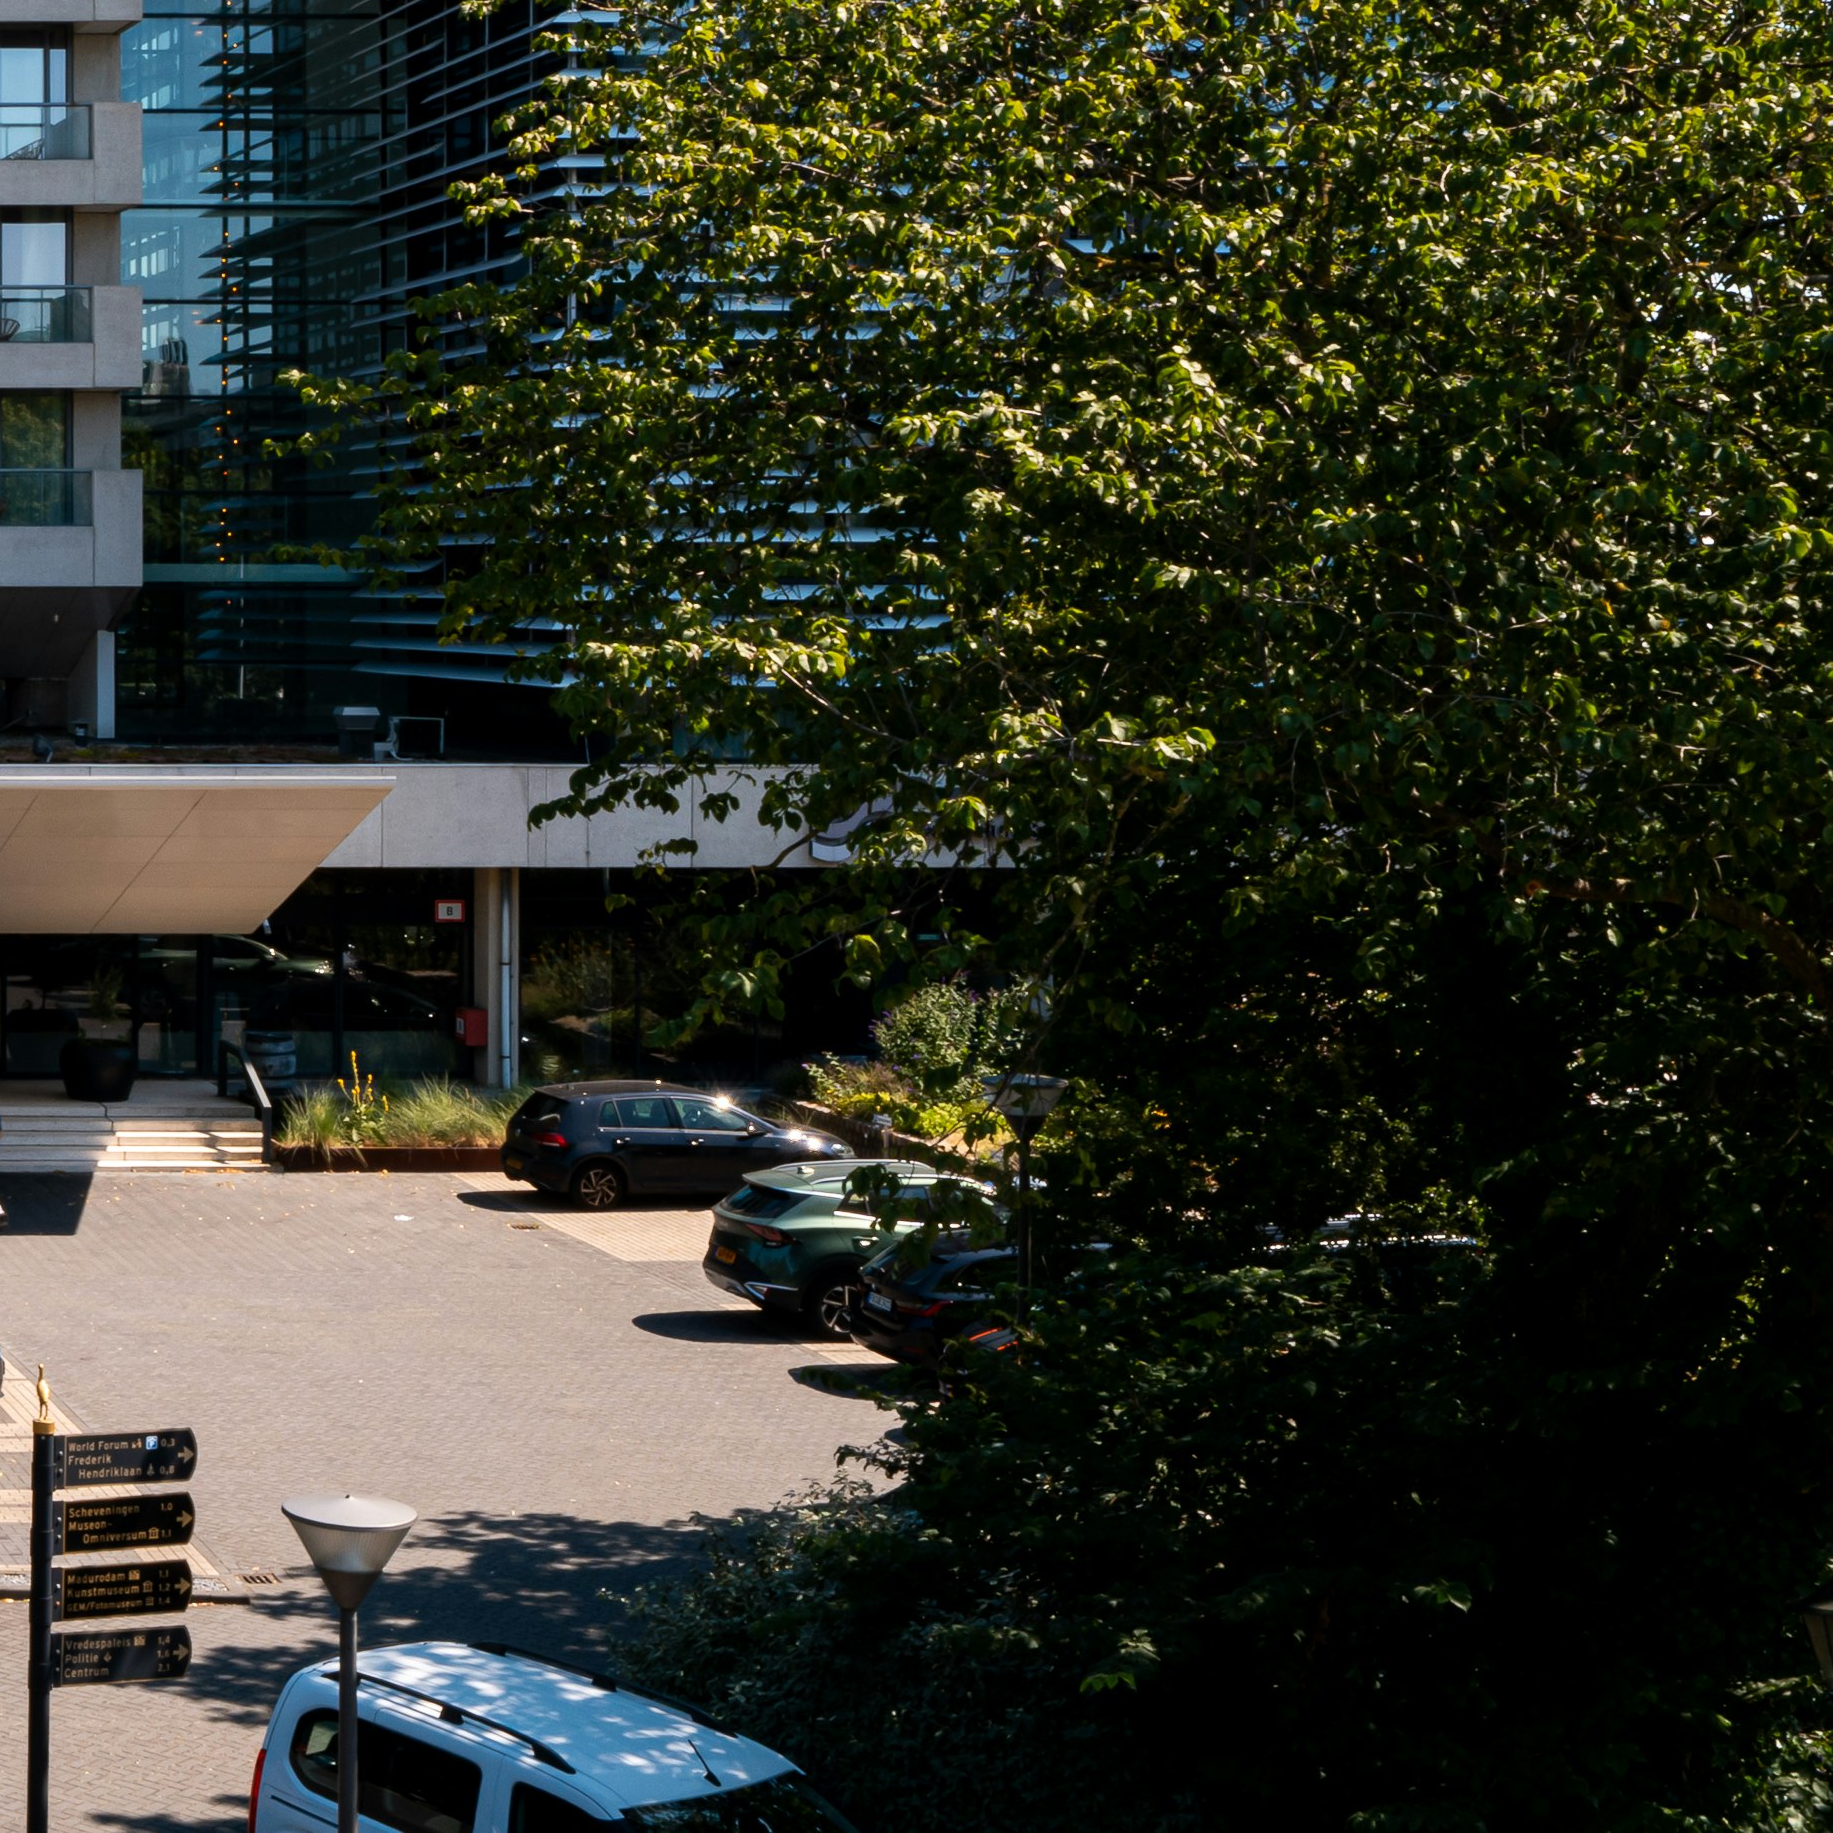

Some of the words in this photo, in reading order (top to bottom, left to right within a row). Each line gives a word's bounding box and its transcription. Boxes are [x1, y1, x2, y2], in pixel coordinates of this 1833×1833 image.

[68, 1442, 95, 1452] World
[98, 1440, 129, 1450] Forum
[68, 1454, 112, 1466] Frederik
[78, 1467, 142, 1479] Hendriklaan
[69, 1504, 140, 1518] Scheveningen
[68, 1521, 112, 1531] Museon-
[83, 1531, 147, 1544] Omniversum
[67, 1572, 126, 1584] Madurodam
[67, 1586, 140, 1598] Kunstmuseum
[66, 1638, 131, 1650] Vredespaleis
[65, 1653, 99, 1664] Politie
[64, 1667, 109, 1678] Centrum
